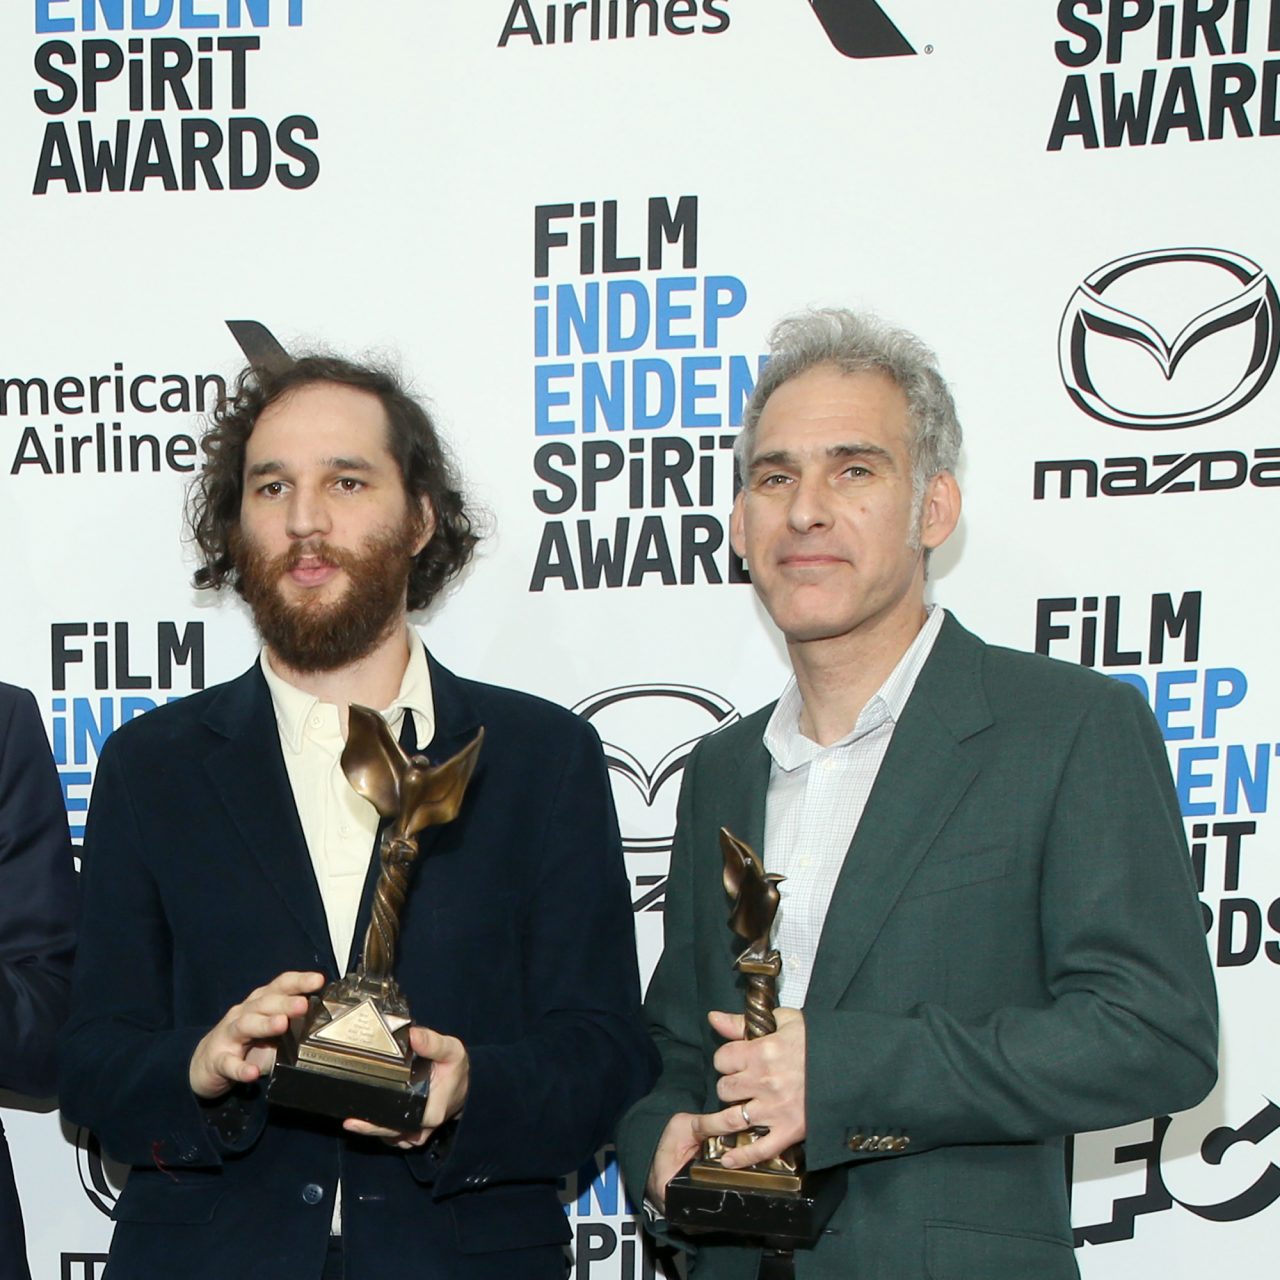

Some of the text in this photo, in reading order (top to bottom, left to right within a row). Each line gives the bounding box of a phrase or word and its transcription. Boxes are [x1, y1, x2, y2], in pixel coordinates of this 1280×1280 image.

[1054, 0, 1280, 68] SPiRi
[33, 35, 261, 115] SPiRiT
[1046, 60, 1280, 151] AWAR
[32, 114, 320, 195] AWARDS
[533, 195, 699, 278] FiLM
[533, 275, 748, 357] iNDEP
[528, 513, 754, 593] AWAR
[50, 621, 206, 691] FiLM
